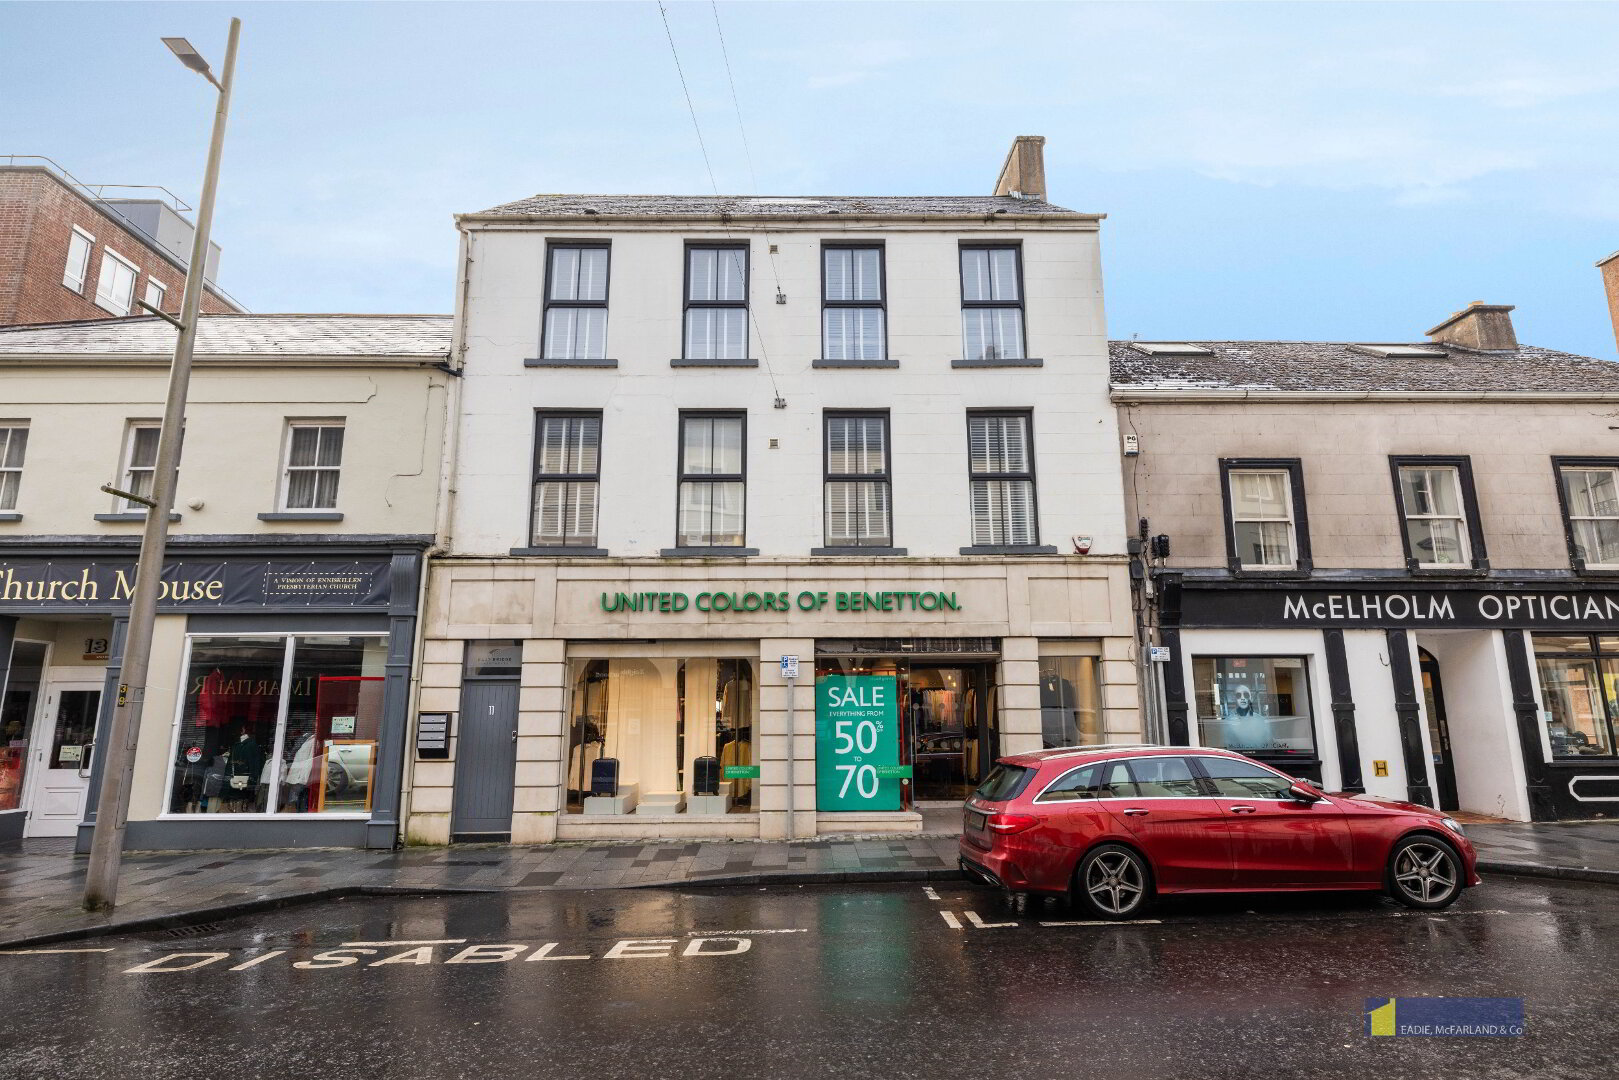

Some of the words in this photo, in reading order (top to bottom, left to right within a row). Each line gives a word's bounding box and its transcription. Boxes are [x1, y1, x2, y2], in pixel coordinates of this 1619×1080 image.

[601, 592, 689, 613] UNITED
[695, 591, 791, 613] COLORS
[796, 590, 829, 612] OF
[835, 591, 963, 613] BENETTON.
[1283, 595, 1456, 620] McELHOLM
[84, 638, 108, 654] 13
[827, 686, 885, 708] SALE
[488, 705, 496, 716] 11
[1375, 761, 1387, 775] H
[835, 764, 880, 799] 70
[121, 938, 753, 973] DISABLED
